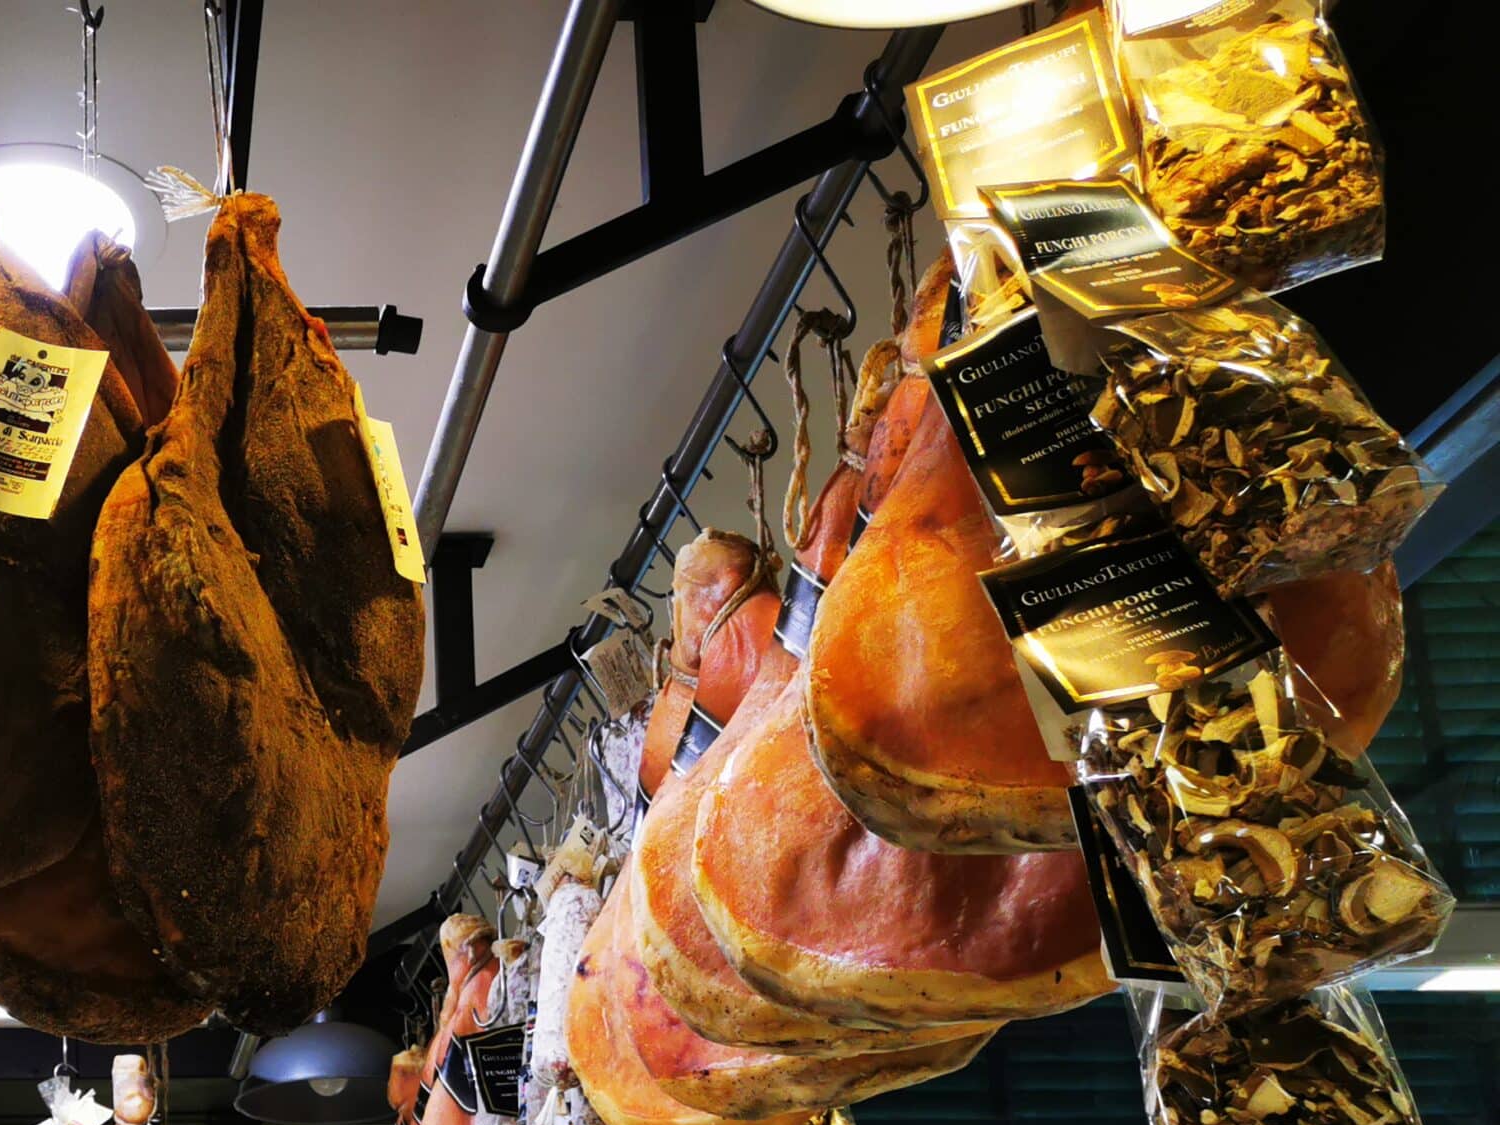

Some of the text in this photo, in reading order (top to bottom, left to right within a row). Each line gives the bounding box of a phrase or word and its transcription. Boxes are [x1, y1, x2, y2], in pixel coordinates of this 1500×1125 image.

[1034, 225, 1148, 254] FUNGHI PORCINI
[973, 379, 1043, 419] FUNGHI
[1024, 379, 1088, 415] SECCHI
[2, 426, 13, 437] di
[1020, 440, 1065, 465] PORCINI
[1020, 551, 1175, 608] GIULIANOTARTUFI
[1036, 576, 1194, 637] FUNGHI PORCINI
[1091, 602, 1160, 630] SECCHI
[1126, 628, 1163, 645] DRIED
[1135, 620, 1211, 649] MUSHROOMS
